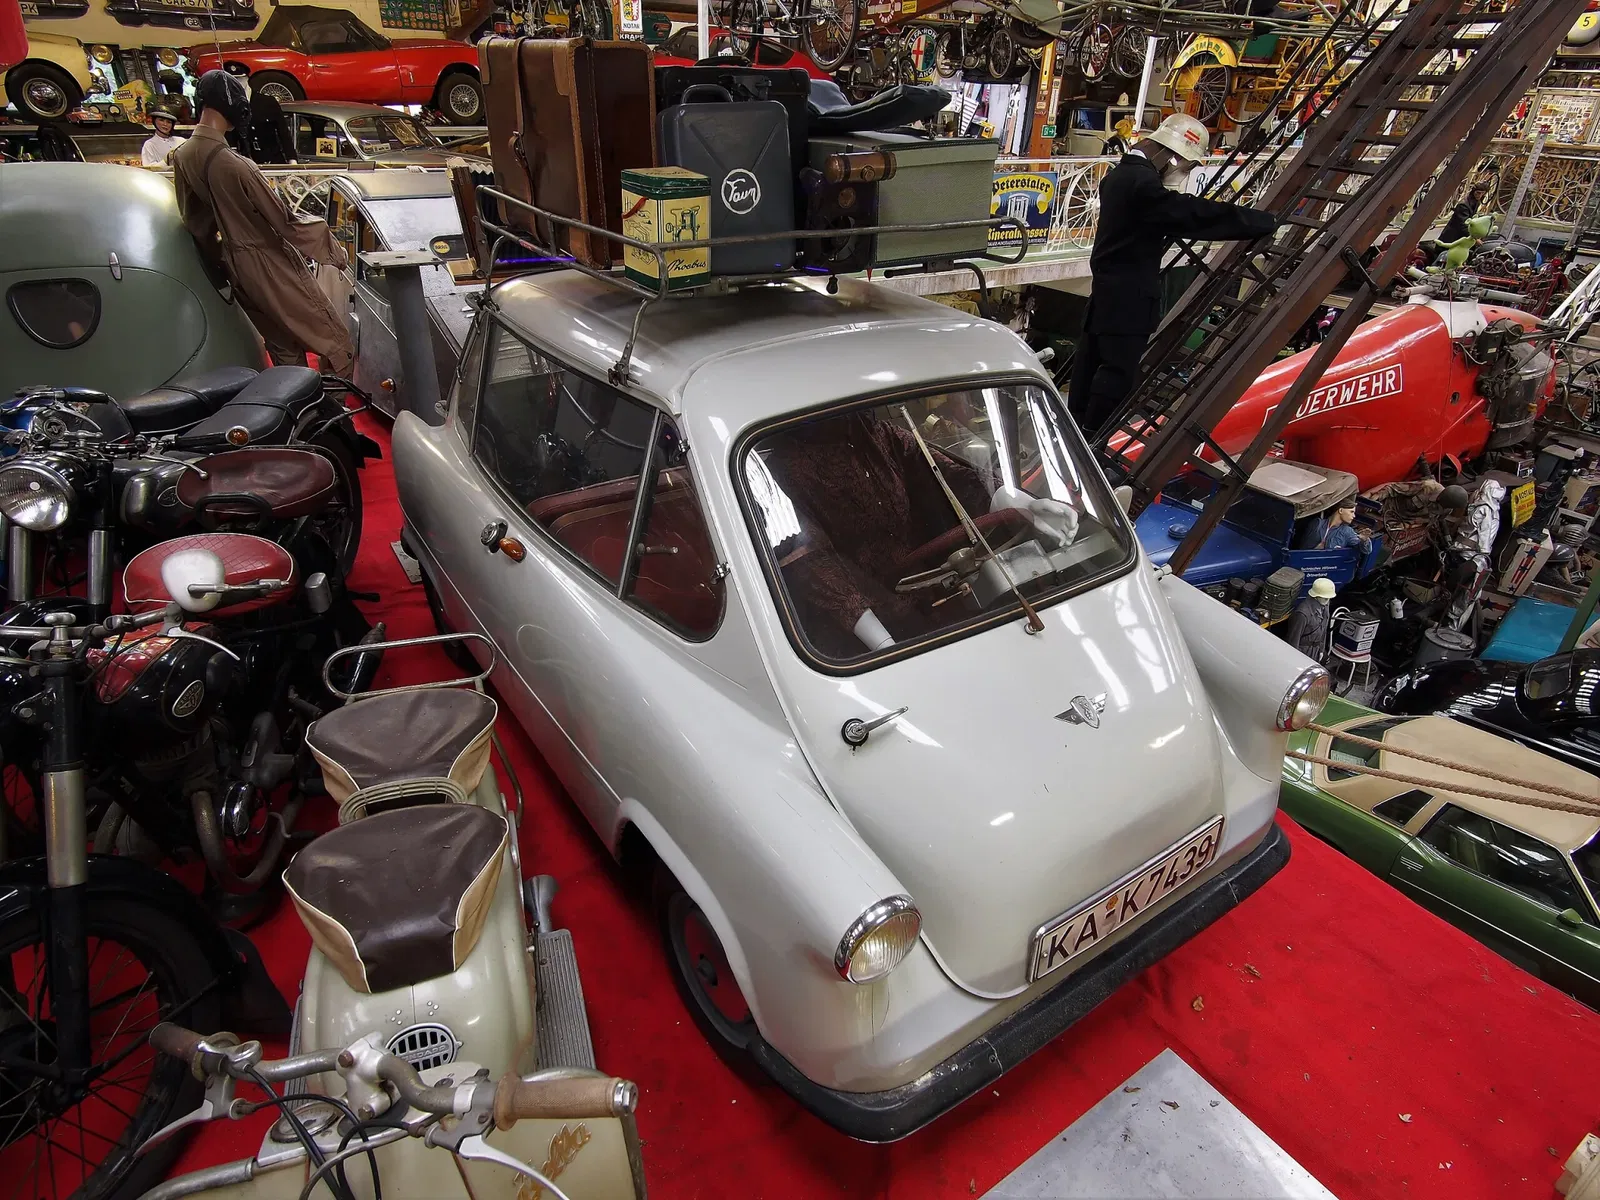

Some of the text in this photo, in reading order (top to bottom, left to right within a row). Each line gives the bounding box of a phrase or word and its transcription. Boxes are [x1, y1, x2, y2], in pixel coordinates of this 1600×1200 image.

[1582, 16, 1591, 27] 5
[667, 258, 707, 272] Phoebus
[1296, 369, 1396, 418] UERWEHR
[401, 1044, 447, 1062] NDAPP
